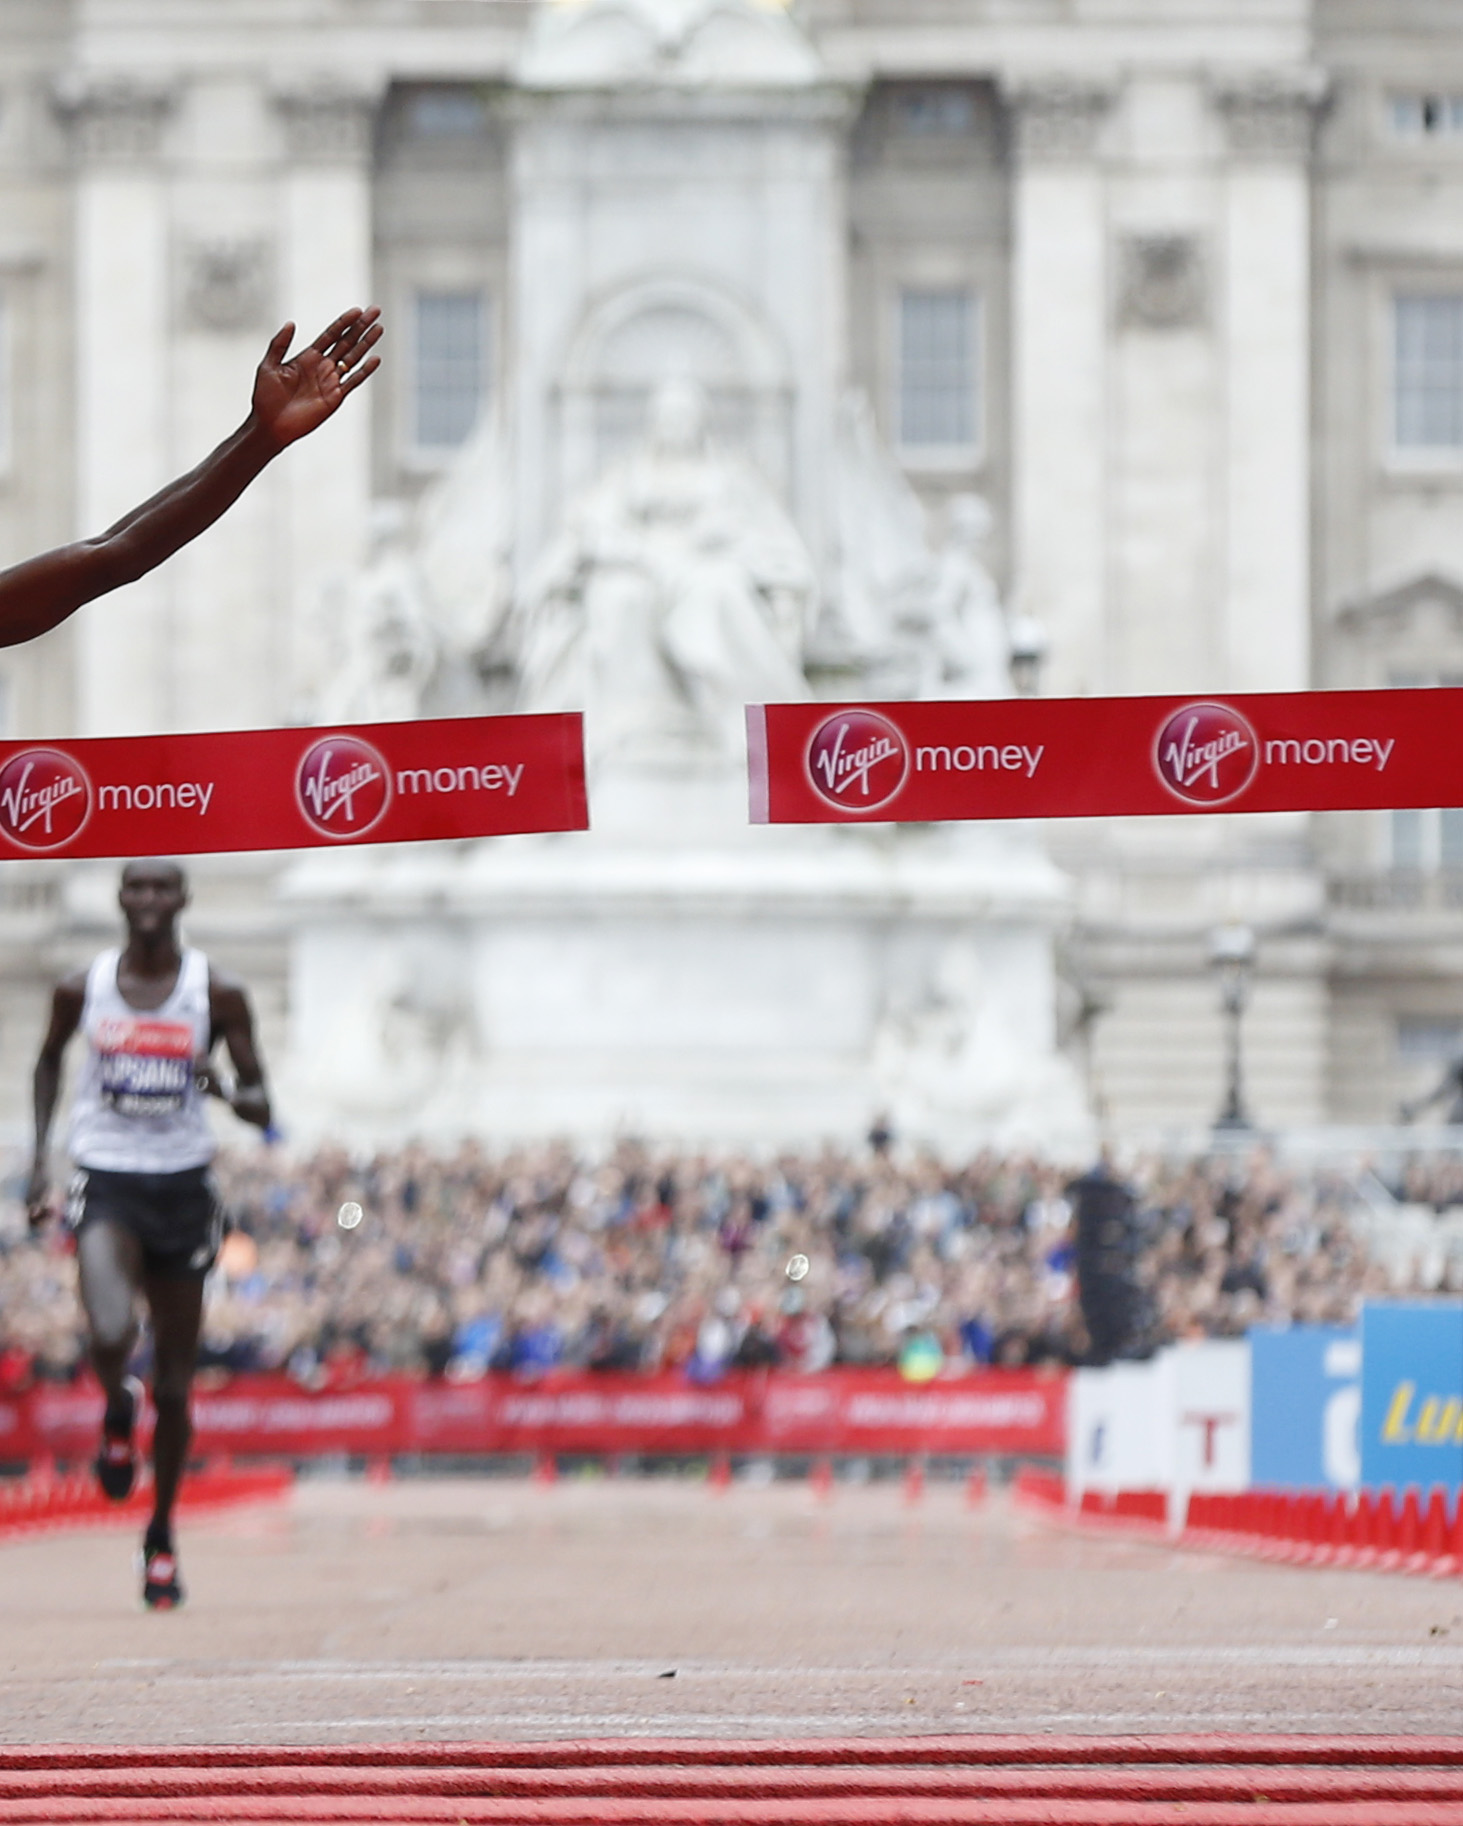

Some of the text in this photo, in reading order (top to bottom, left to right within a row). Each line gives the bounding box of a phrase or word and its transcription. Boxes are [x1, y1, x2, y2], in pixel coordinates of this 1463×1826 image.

[305, 751, 525, 822] Virgin money
[817, 724, 1045, 795] Virgin money
[1166, 716, 1395, 788] Virgin money
[1, 762, 214, 834] Virgin money
